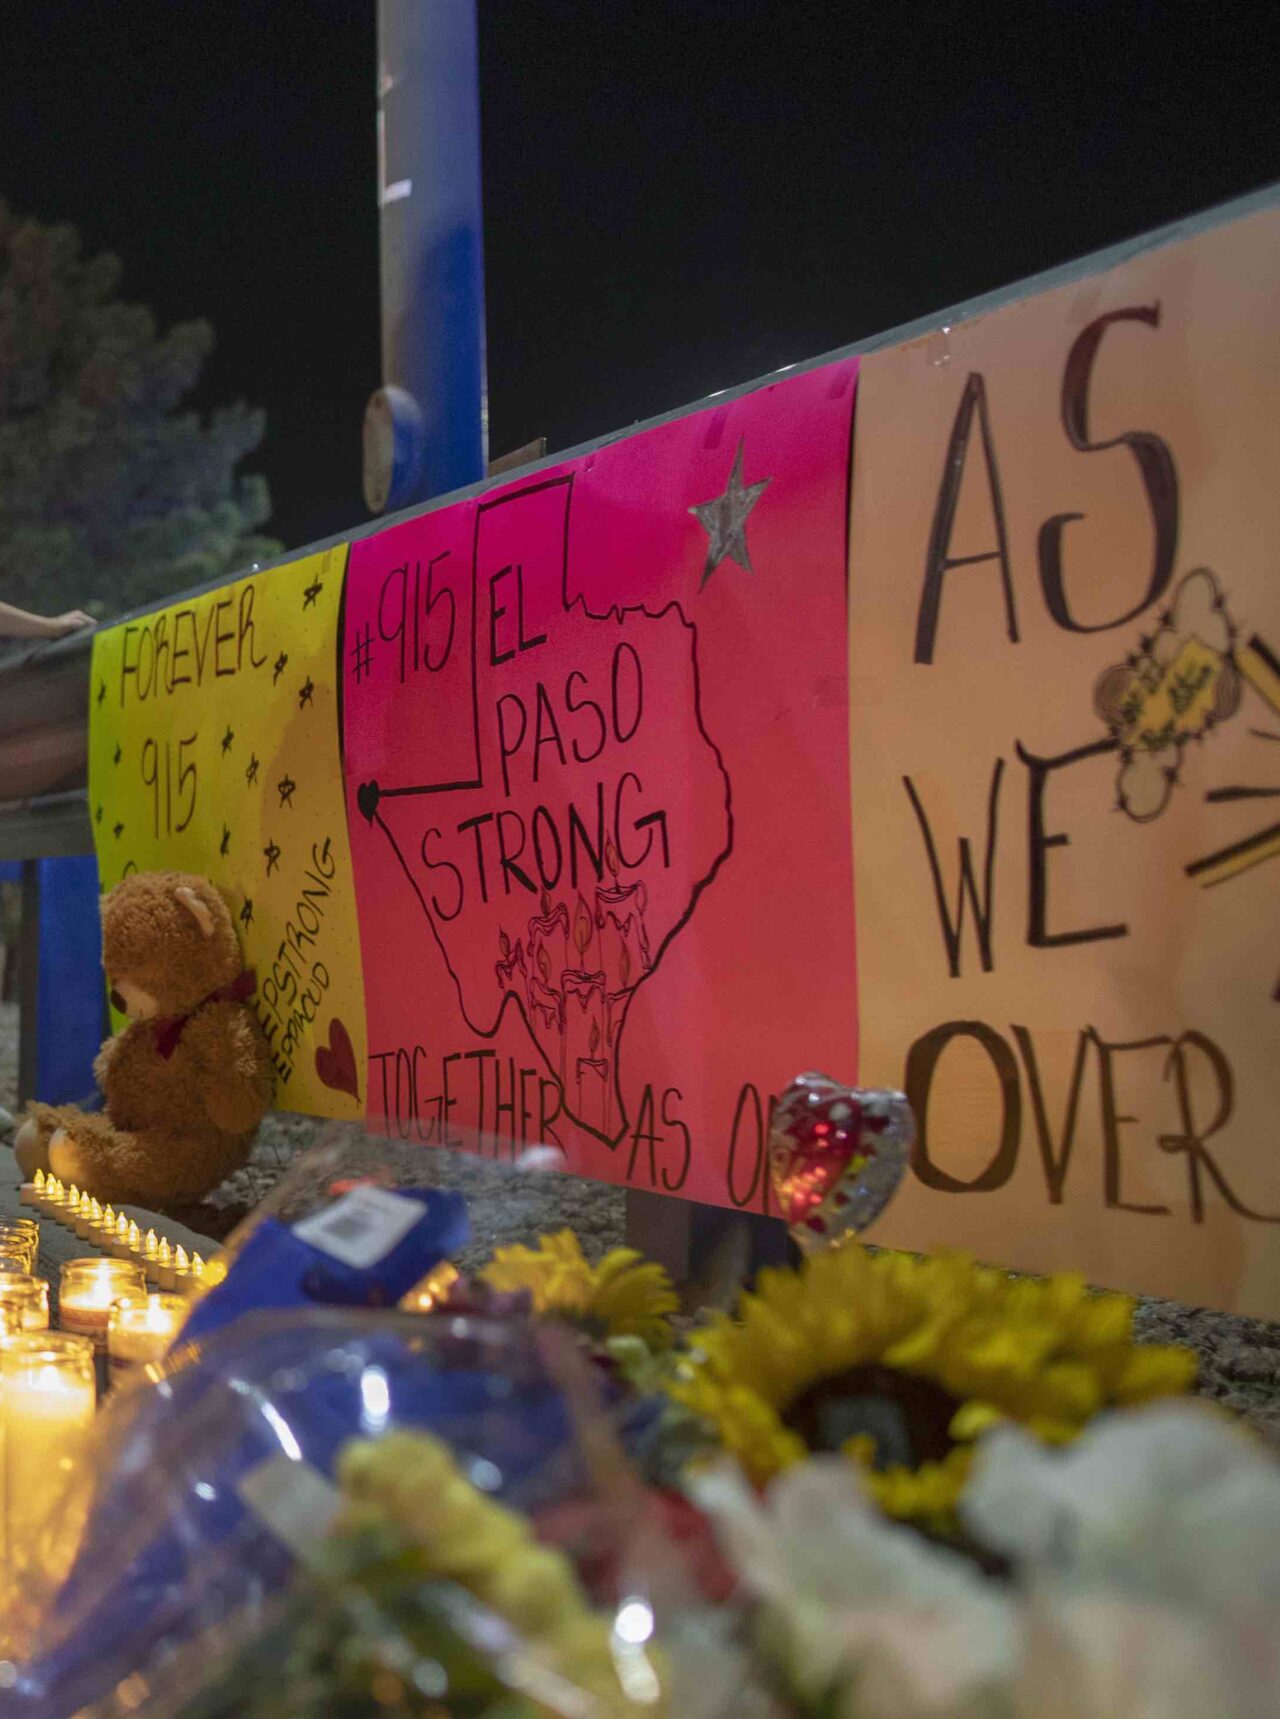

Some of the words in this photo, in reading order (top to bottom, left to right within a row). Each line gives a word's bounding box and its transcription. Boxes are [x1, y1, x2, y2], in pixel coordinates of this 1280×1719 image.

[914, 301, 1180, 665] AS
[120, 584, 267, 708] FOREVER
[351, 550, 456, 684] #915
[489, 565, 547, 665] EL
[141, 733, 198, 839] 915
[496, 642, 643, 797] PASO
[420, 772, 671, 920] STRONG
[903, 739, 1129, 978] WE
[369, 1047, 567, 1160] TOGETHER
[627, 1084, 690, 1191] AS
[904, 1020, 1280, 1223] OVER
